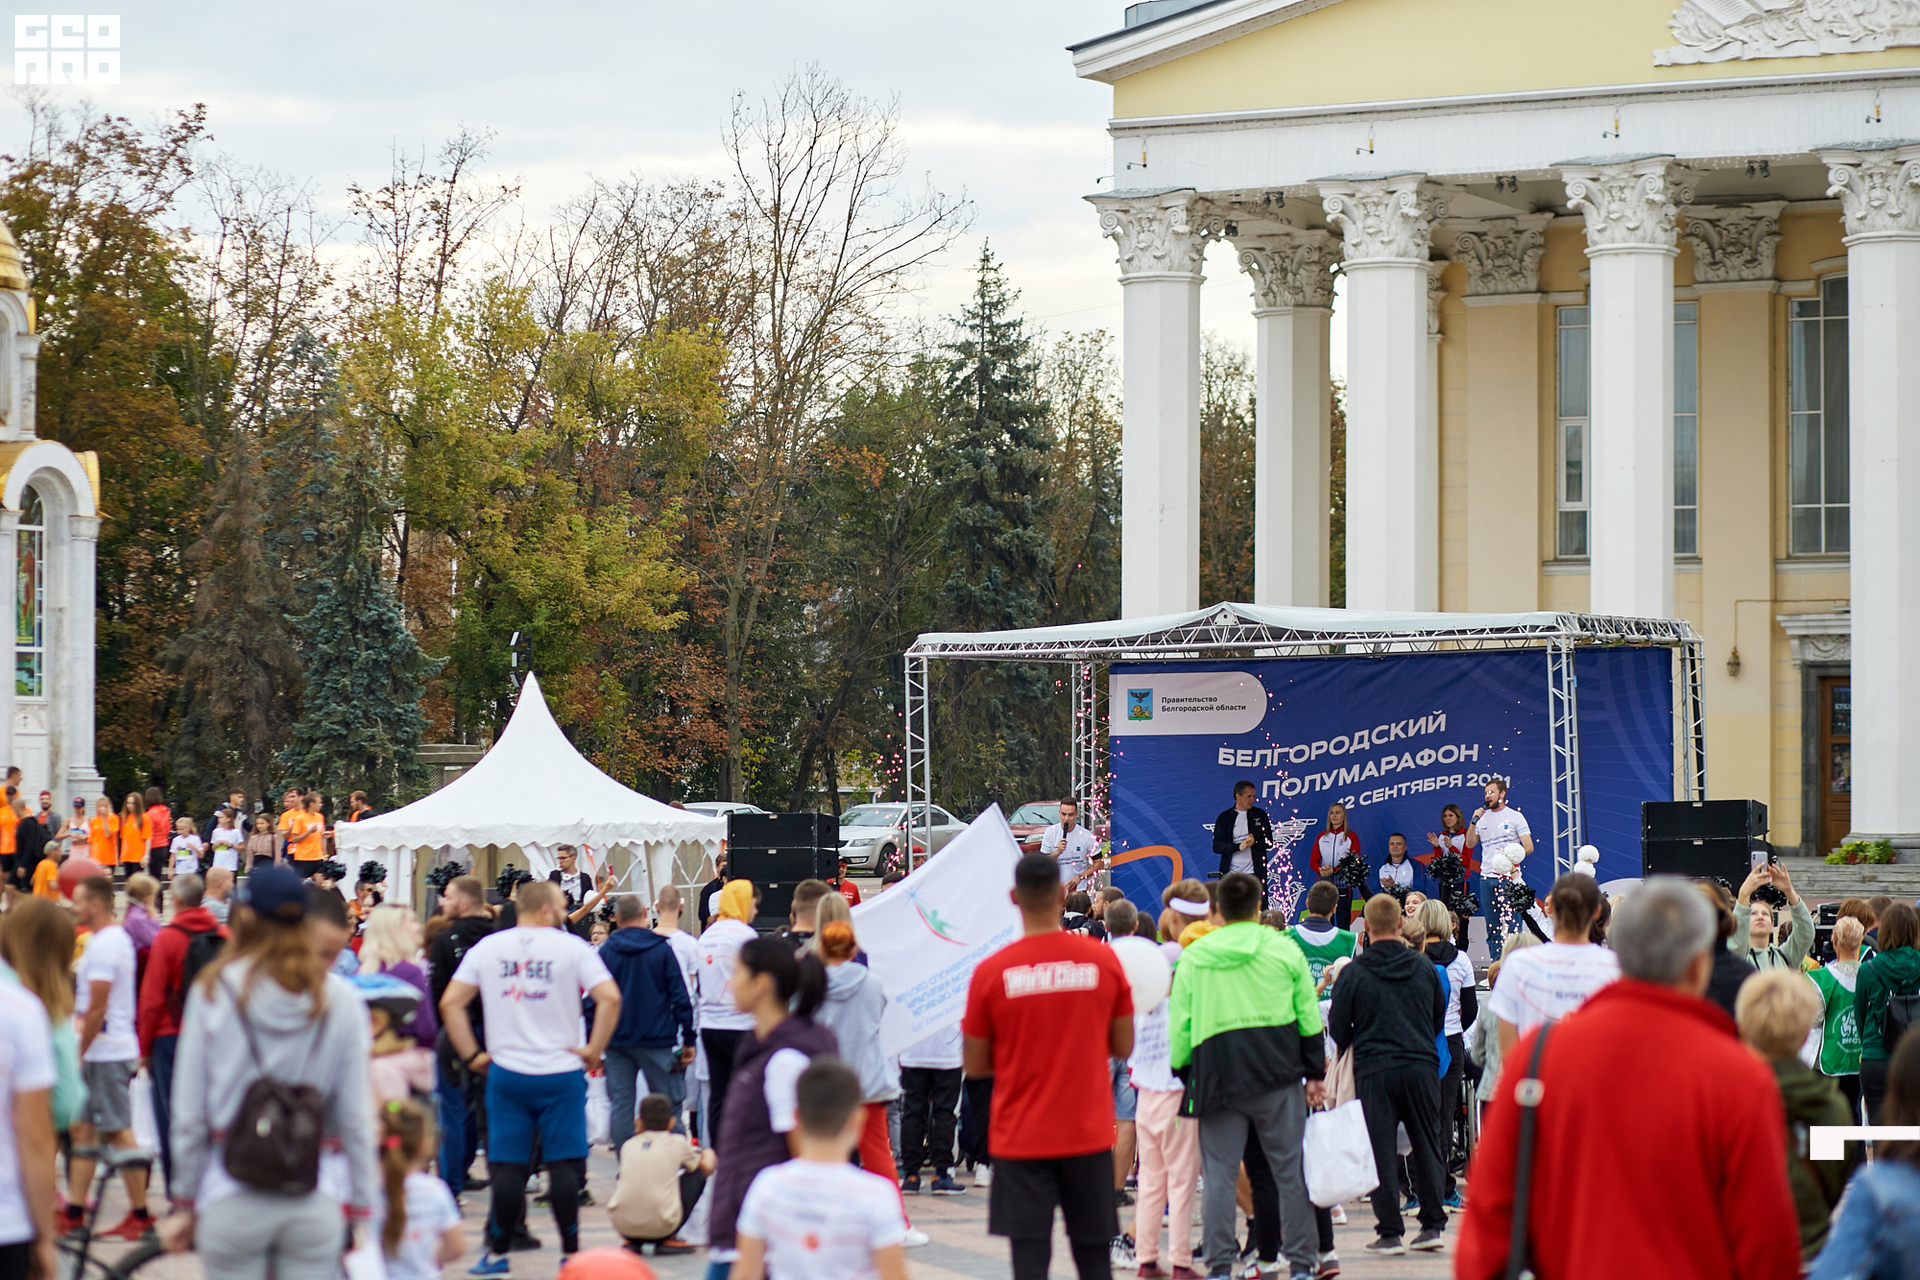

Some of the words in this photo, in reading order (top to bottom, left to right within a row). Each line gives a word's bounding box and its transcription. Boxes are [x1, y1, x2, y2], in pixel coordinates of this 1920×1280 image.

[1161, 696, 1218, 704] Правительство
[1161, 704, 1214, 713] Белгородской
[1218, 709, 1447, 768] БЕЛГОРОДСКИЙ
[1261, 743, 1480, 799] ПОЛУМАРАФОН
[1359, 774, 1462, 806] СЕНТЯБРЯ
